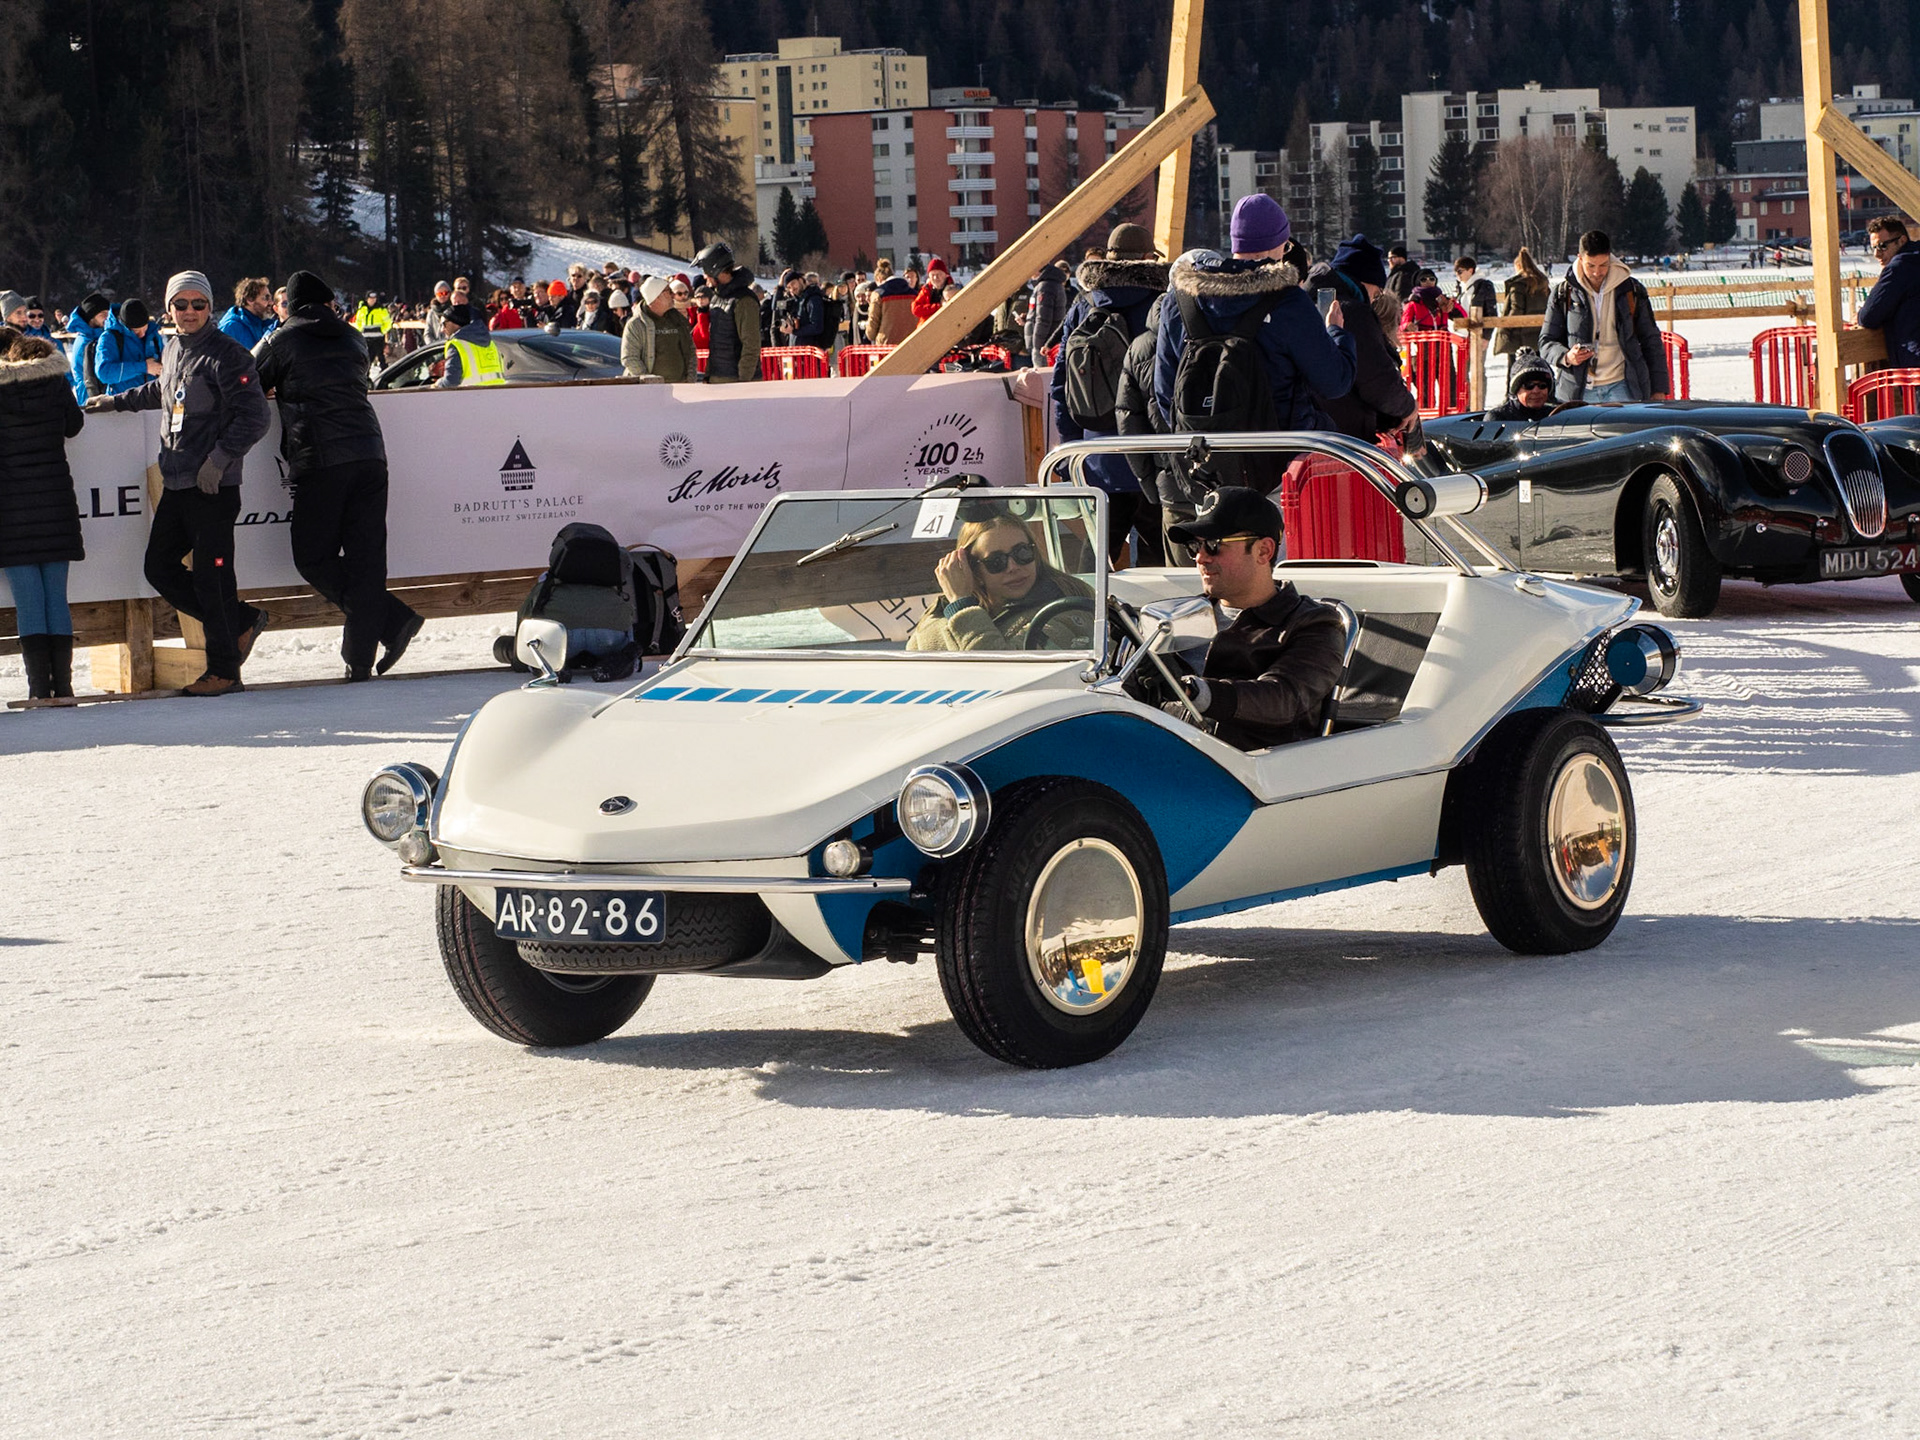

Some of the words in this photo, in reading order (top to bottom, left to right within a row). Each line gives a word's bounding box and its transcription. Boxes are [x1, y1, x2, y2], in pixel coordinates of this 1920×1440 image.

[914, 441, 959, 467] 100
[667, 469, 703, 503] St.
[694, 461, 783, 498] Moritz
[917, 466, 950, 476] YEARS
[78, 485, 142, 519] LE
[453, 498, 530, 513] BADRUTT'S
[536, 495, 584, 508] PALACE
[695, 504, 711, 512] TOP
[728, 503, 744, 511] THE
[461, 517, 475, 525] ST.
[479, 514, 511, 523] MORITZ
[516, 510, 577, 521] SWITZERLAND
[921, 515, 944, 534] 41
[1825, 551, 1869, 574] MDU
[1876, 547, 1918, 571] 524
[496, 893, 658, 936] AR-82-86
